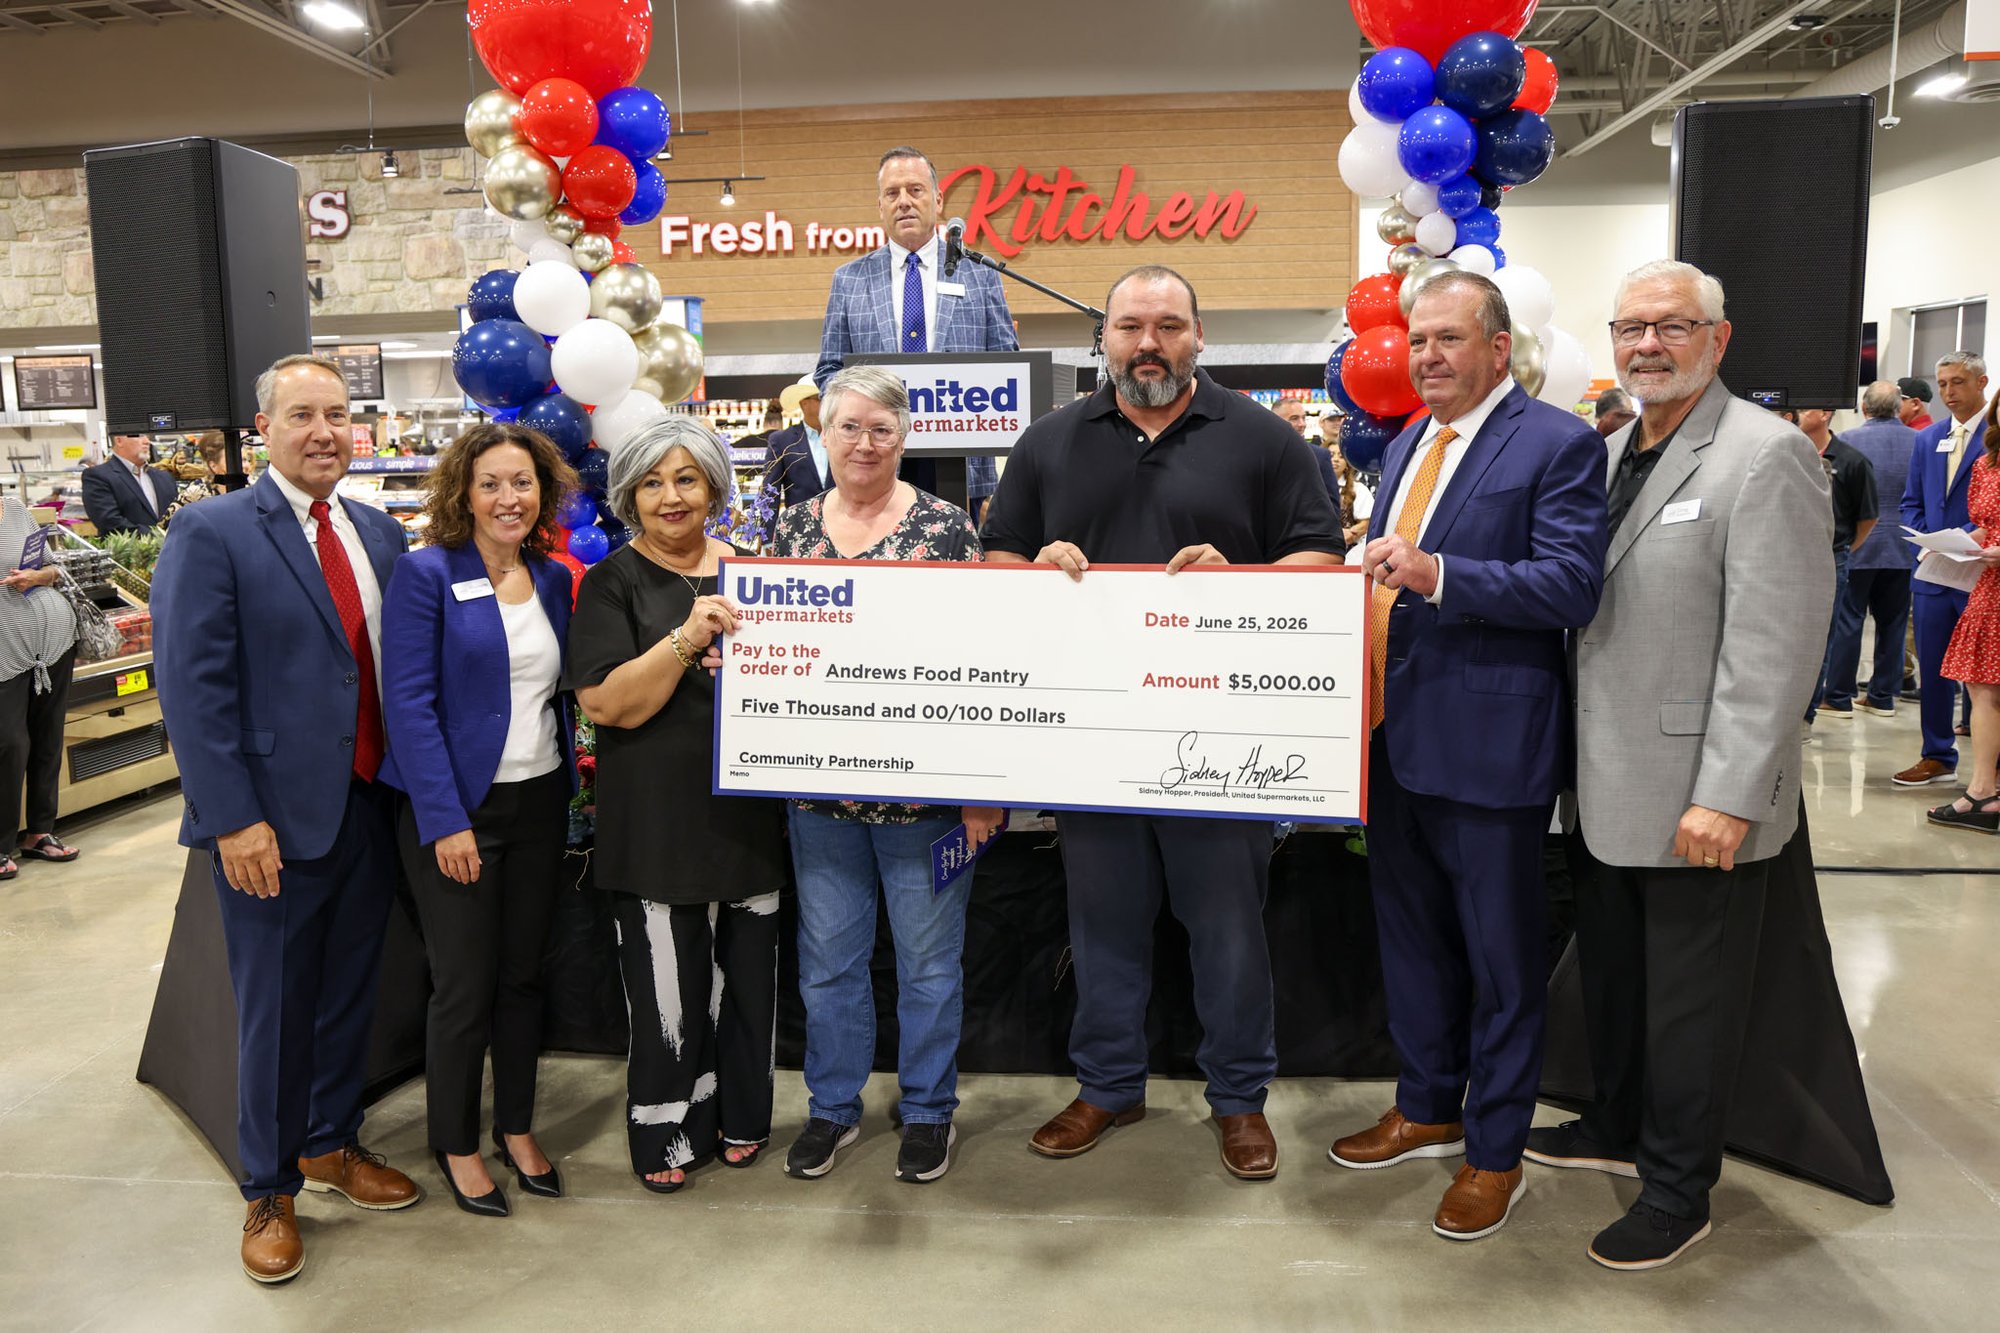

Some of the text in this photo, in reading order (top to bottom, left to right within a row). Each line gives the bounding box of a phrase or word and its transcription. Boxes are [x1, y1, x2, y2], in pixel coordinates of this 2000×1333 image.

[661, 211, 793, 254] Fresh
[806, 222, 885, 249] from
[939, 163, 1258, 258] Kitchen
[902, 378, 1018, 413] nited
[907, 414, 1018, 432] ermarkets
[385, 458, 415, 472] simple
[731, 450, 766, 461] deliciou
[737, 576, 854, 607] United
[737, 608, 854, 625] supermarkets
[1145, 612, 1308, 631] Date June 25, 2026
[732, 643, 821, 659] Pay to the
[740, 661, 812, 677] order of
[825, 664, 1029, 687] Andrews Food Pantry
[1142, 673, 1336, 692] Amount $5,000.00
[741, 699, 1066, 724] Five Thousand and 00/100 Dollars
[739, 752, 914, 771] Community Partnership
[1160, 730, 1231, 794] Sidney
[1139, 787, 1163, 795] Sidney
[1164, 788, 1193, 797] Hopper,
[1194, 790, 1230, 798] President,
[1231, 791, 1256, 799] United
[1257, 793, 1311, 803] Supermarkets,
